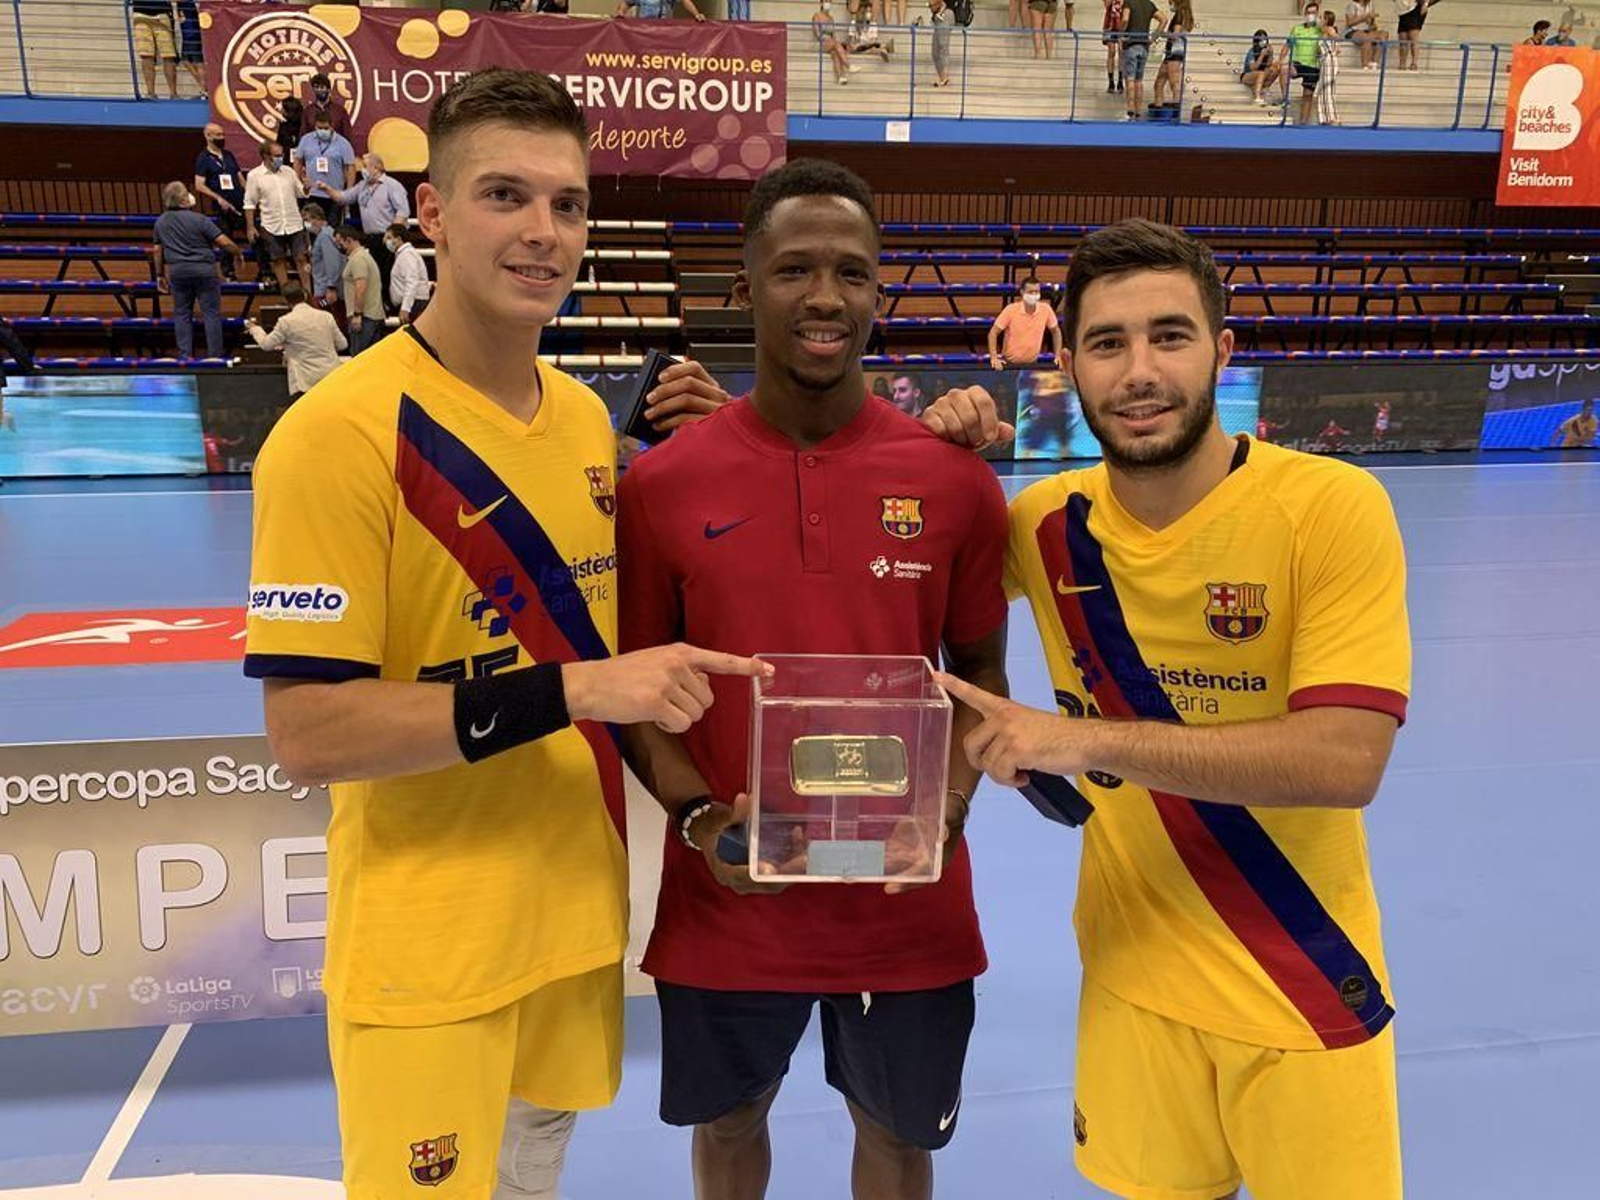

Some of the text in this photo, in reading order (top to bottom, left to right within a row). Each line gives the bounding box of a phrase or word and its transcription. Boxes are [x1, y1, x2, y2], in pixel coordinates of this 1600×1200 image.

[247, 29, 335, 62] HOTELES
[585, 51, 773, 75] www.servigroup.es
[548, 74, 773, 112] ERVIGROUP
[1520, 105, 1556, 122] city&
[1518, 119, 1572, 134] beaches
[588, 120, 687, 160] deporte
[1509, 157, 1539, 172] Visit
[1507, 172, 1573, 187] Benidorm
[205, 755, 331, 801] Sac
[165, 976, 232, 997] LaLiga
[165, 993, 252, 1015] SportsTV
